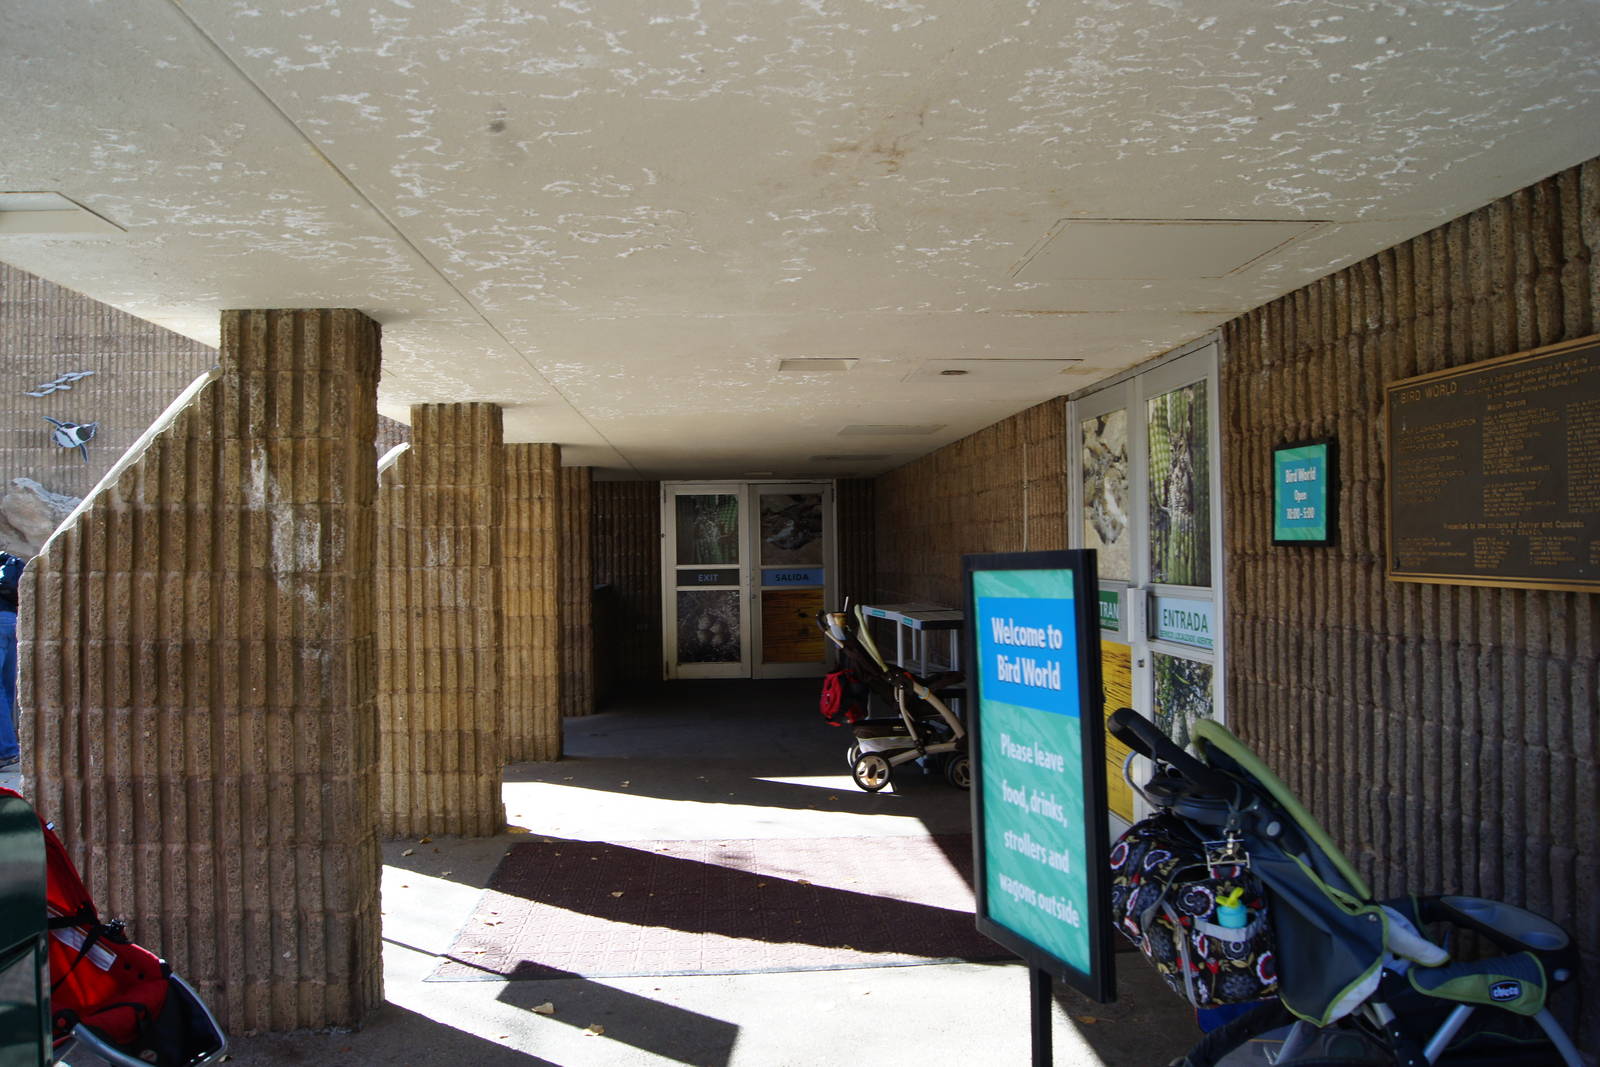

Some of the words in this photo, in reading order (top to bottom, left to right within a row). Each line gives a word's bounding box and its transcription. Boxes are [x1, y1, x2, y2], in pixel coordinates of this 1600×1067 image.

[1400, 390, 1421, 404] BIRD
[1424, 381, 1457, 398] WORLD
[1285, 469, 1297, 483] Bird
[1297, 466, 1316, 481] World
[1294, 489, 1308, 504] Open
[698, 574, 719, 582] EXIT
[775, 573, 809, 582] SALIDA
[991, 617, 1046, 648] Welcome
[1047, 624, 1063, 649] to
[1163, 608, 1208, 633] ENTRADA
[996, 654, 1021, 684] Bird
[1021, 658, 1061, 690] World
[1000, 733, 1033, 764] Please
[1034, 742, 1065, 772] leave
[1002, 779, 1029, 814] food,
[1030, 789, 1068, 828] drinks,
[1004, 829, 1047, 864] strollers
[1048, 849, 1070, 874] and
[998, 873, 1037, 906] wagons
[1038, 892, 1080, 928] outside
